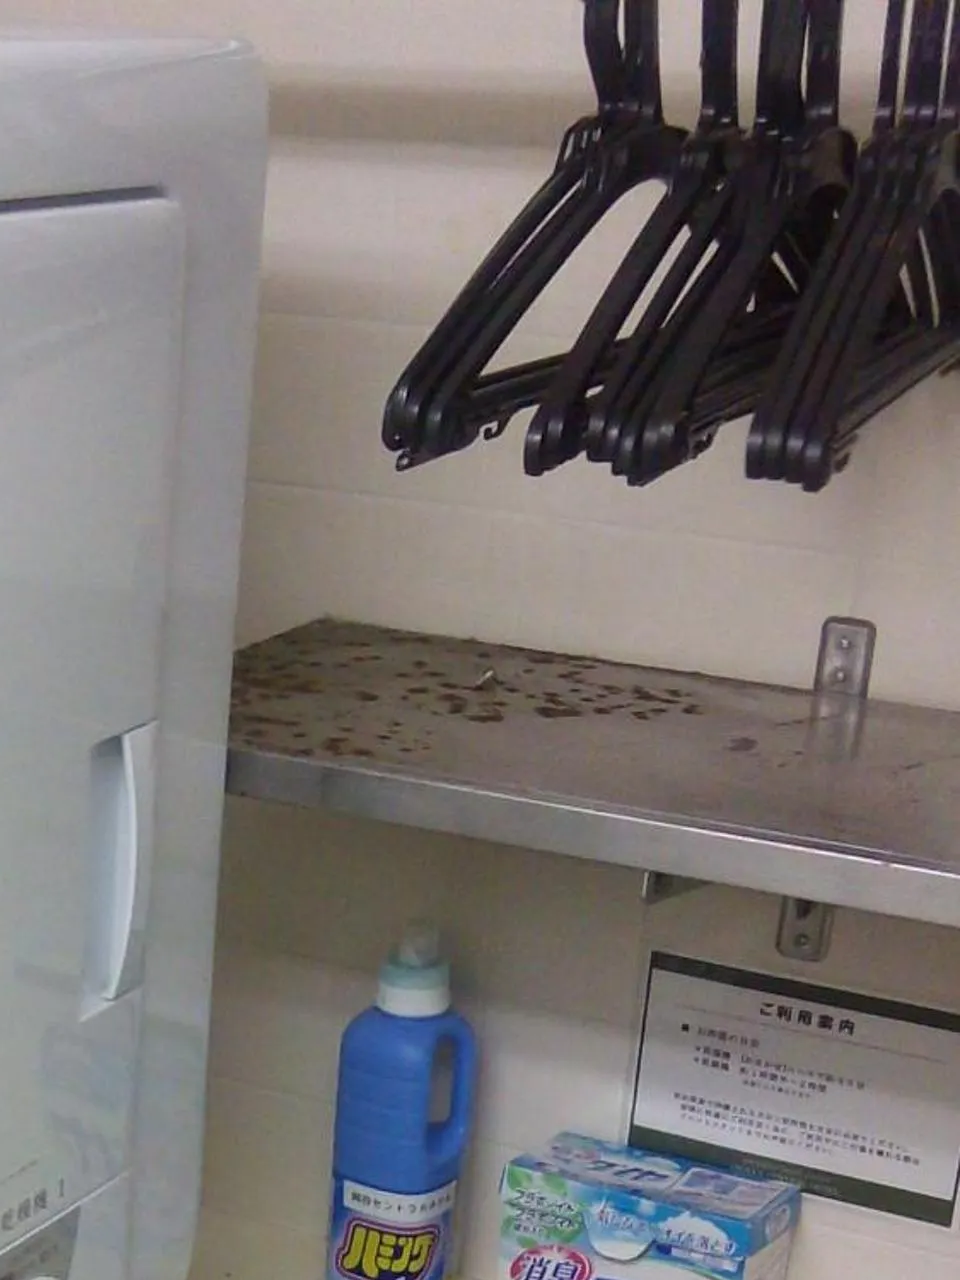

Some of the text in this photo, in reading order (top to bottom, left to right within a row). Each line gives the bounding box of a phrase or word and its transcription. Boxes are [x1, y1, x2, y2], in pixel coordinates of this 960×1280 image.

[759, 1001, 856, 1037] ご利用案内
